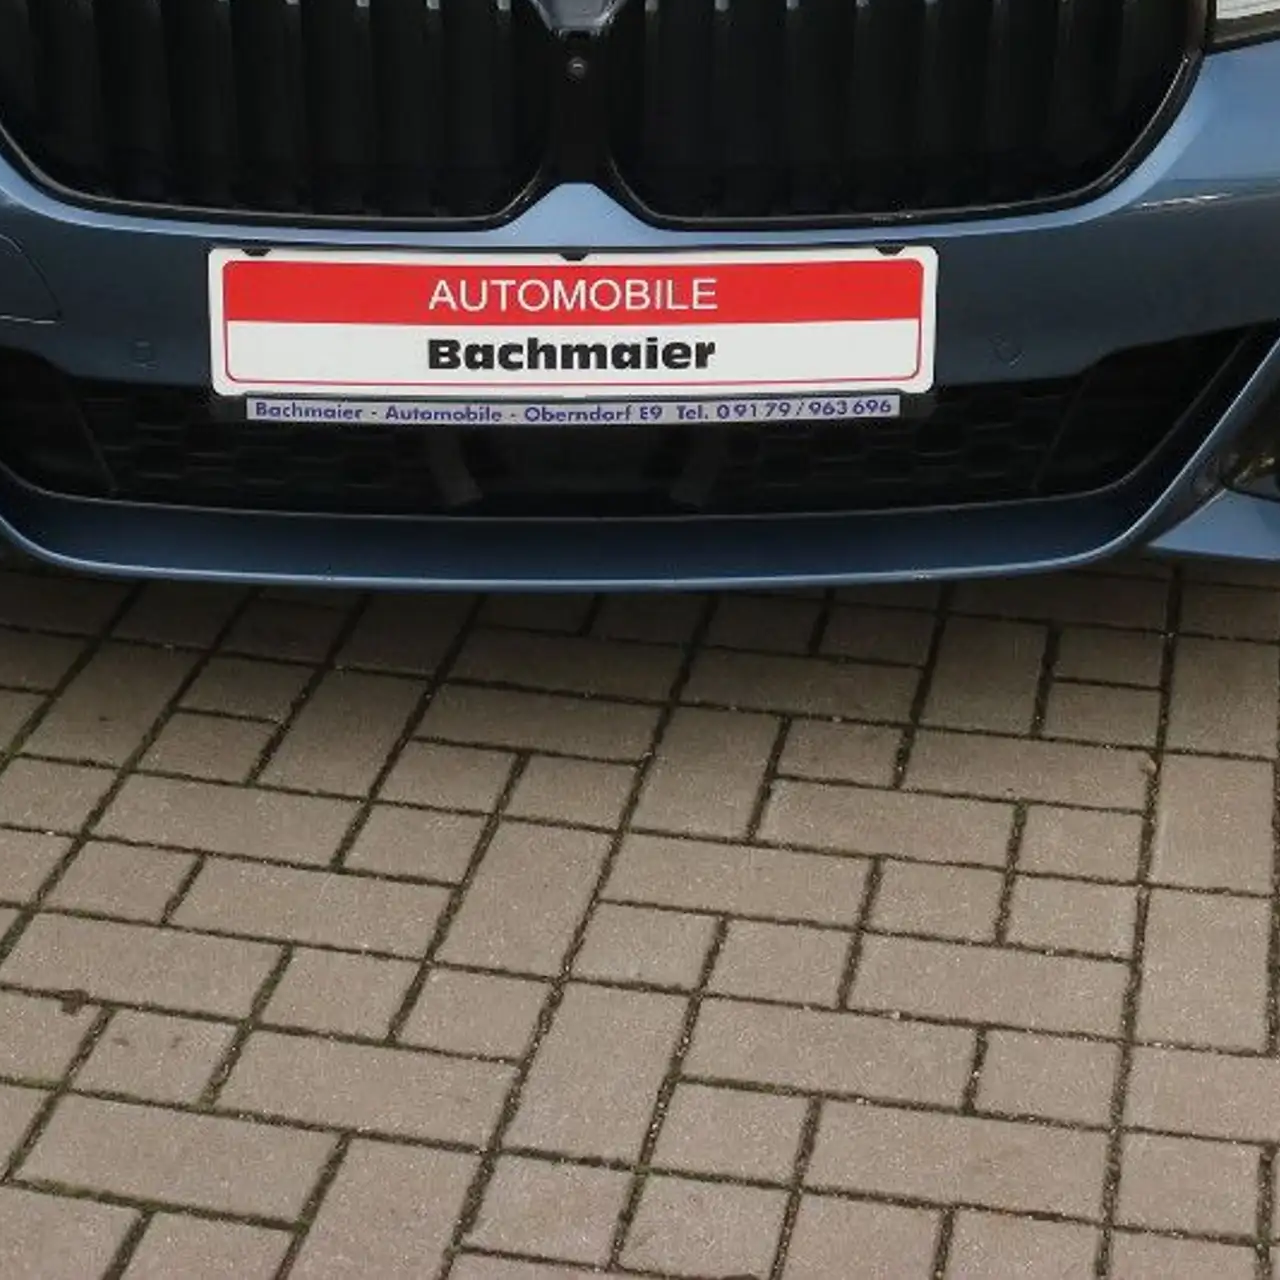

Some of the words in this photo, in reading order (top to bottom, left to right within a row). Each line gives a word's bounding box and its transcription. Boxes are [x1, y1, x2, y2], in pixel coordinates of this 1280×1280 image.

[428, 278, 718, 312] AUTOMOBILE
[427, 337, 716, 371] Bachmaier
[254, 401, 363, 421] Bachmaier
[384, 404, 503, 423] Automobile
[524, 403, 633, 422] Oberndorf
[676, 405, 709, 421] Tel.
